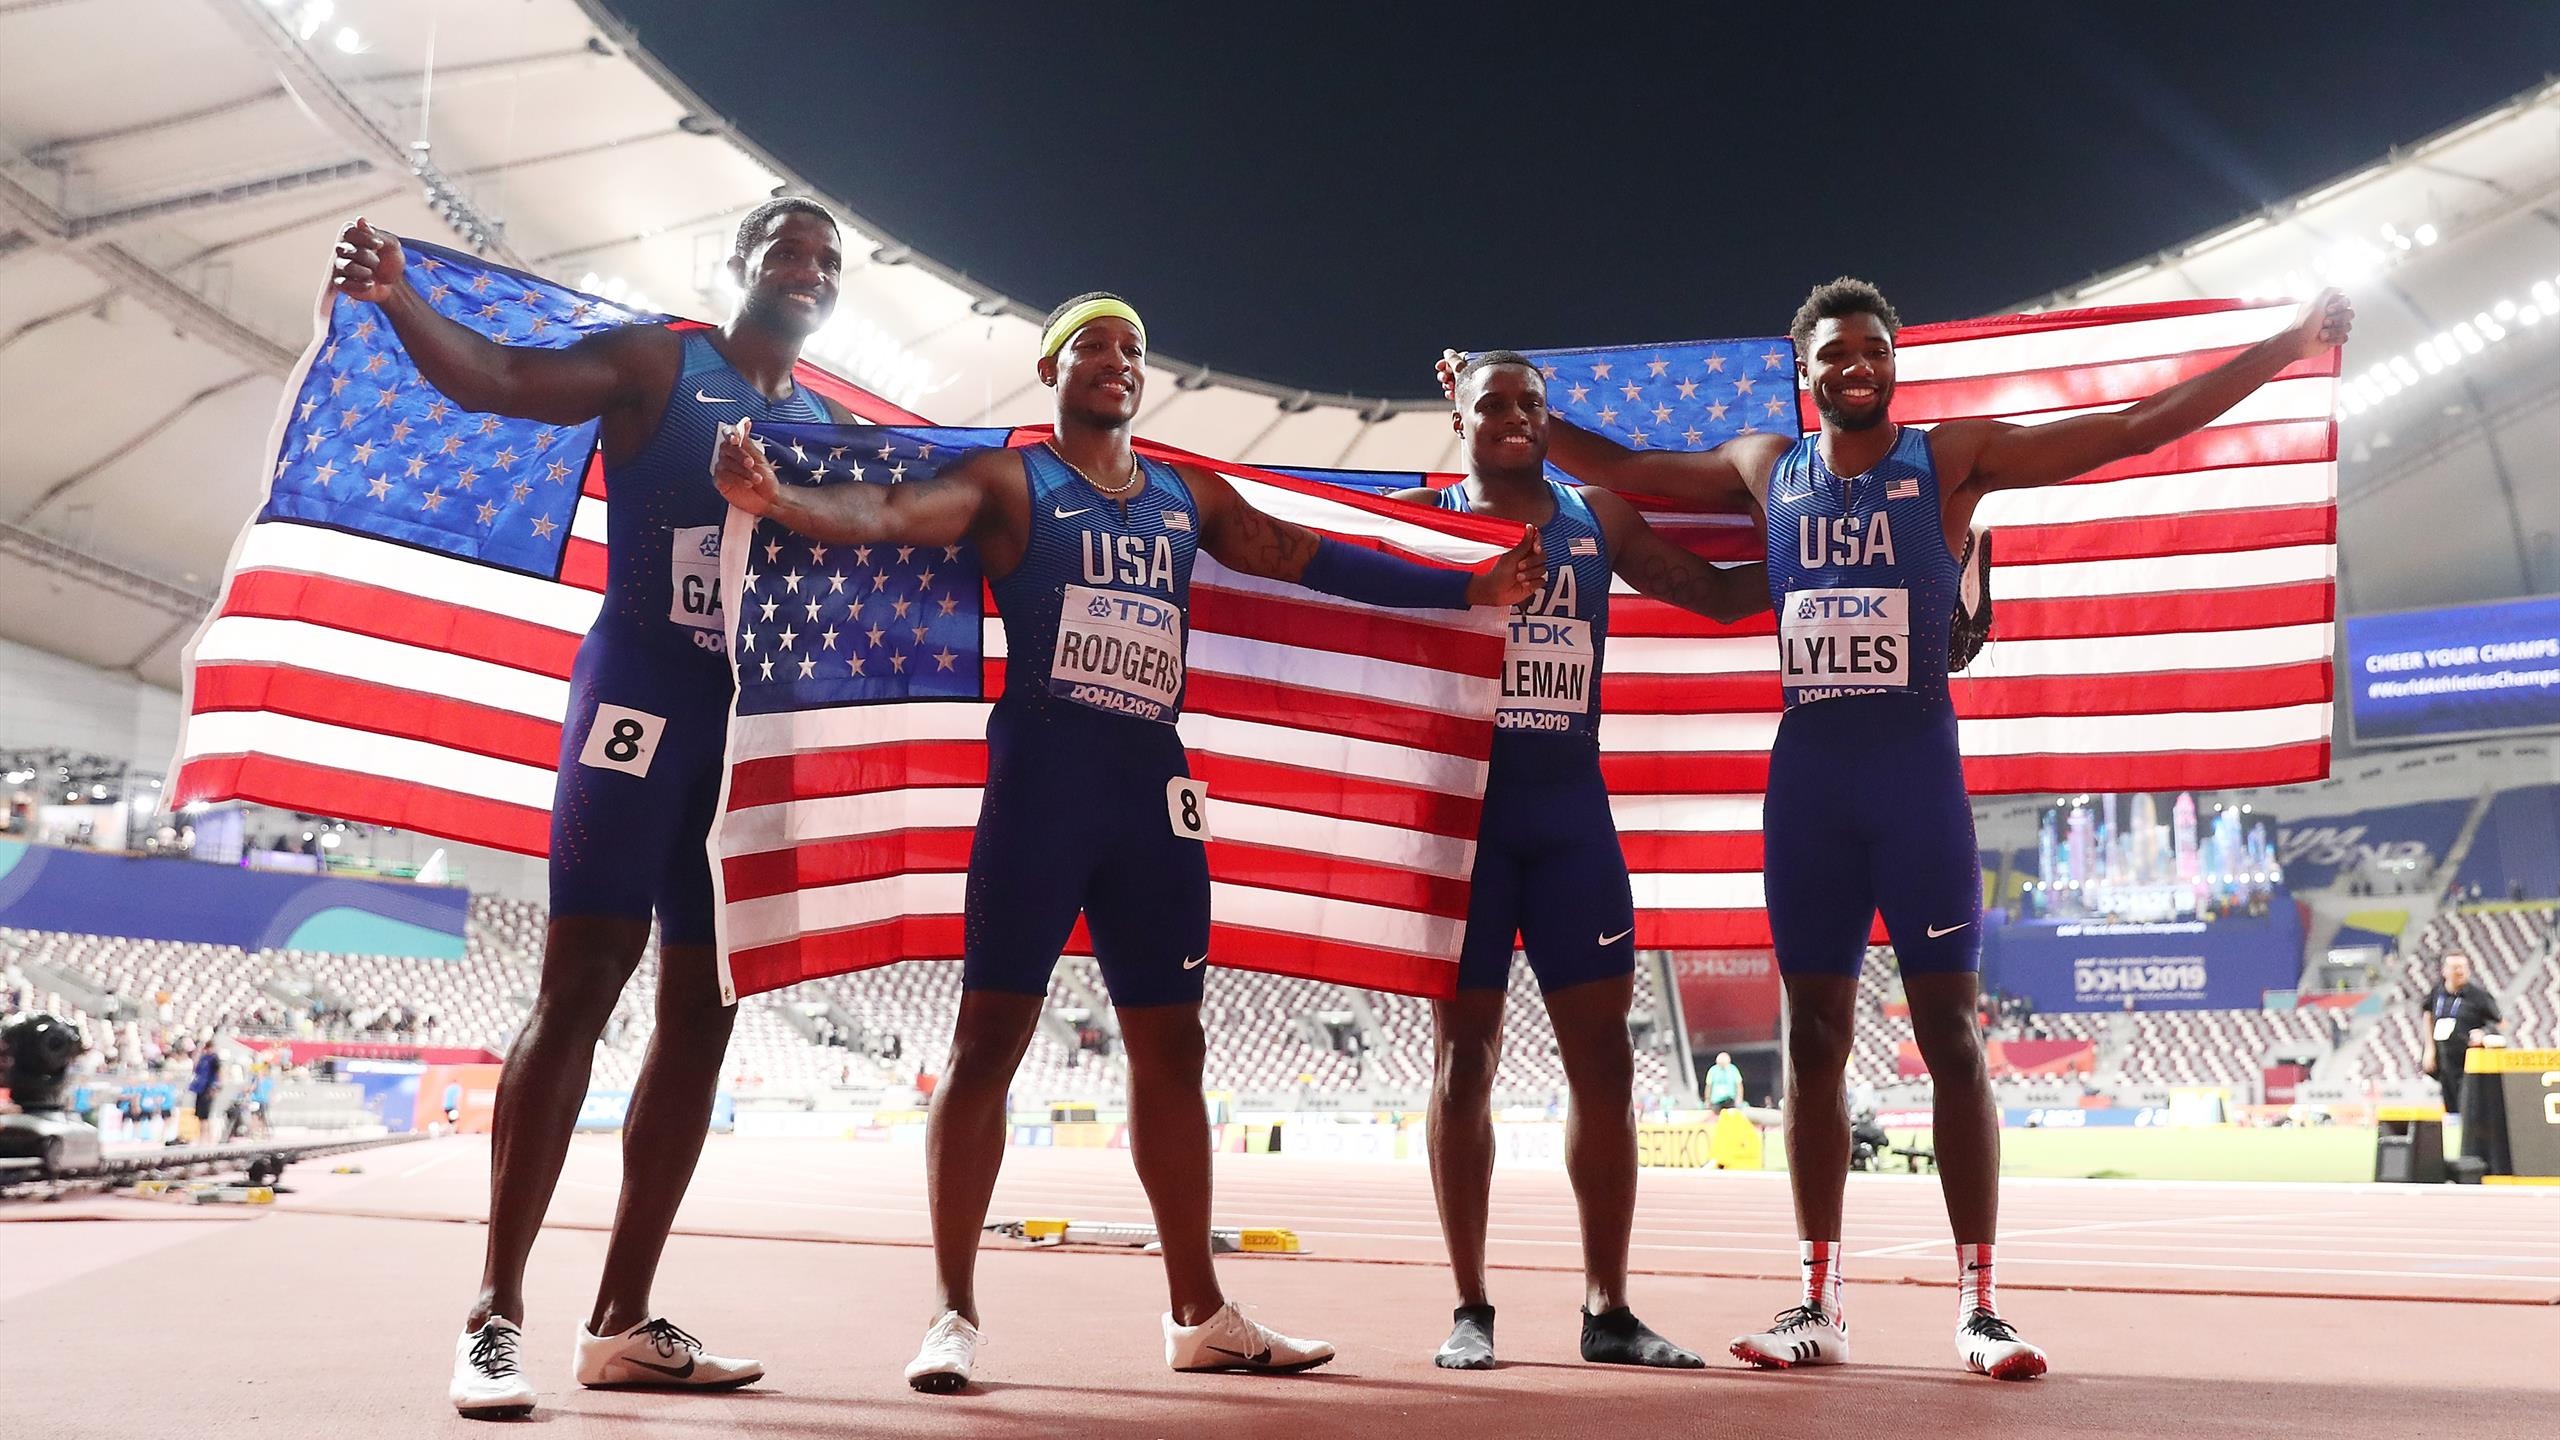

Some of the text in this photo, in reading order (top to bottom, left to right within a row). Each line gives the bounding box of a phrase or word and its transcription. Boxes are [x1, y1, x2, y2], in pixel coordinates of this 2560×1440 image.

[1800, 510, 1895, 569] USA
[1081, 529, 1174, 594] USA
[1112, 598, 1174, 636] TDK
[1816, 595, 1887, 619] TDK
[1508, 622, 1574, 647] TDK
[1060, 630, 1179, 695] RODGERS
[1787, 635, 1898, 675] LYLES
[2366, 638, 2560, 673] CHEER YOUR CHAMPS
[1501, 660, 1585, 701] LEMAN
[1070, 684, 1161, 721] DOHA2019
[1496, 711, 1570, 732] OHA2019
[604, 718, 644, 762] 8
[1180, 788, 1201, 832] 8
[2075, 965, 2207, 993] DOHA2019
[1638, 1128, 1711, 1169] SEIKO
